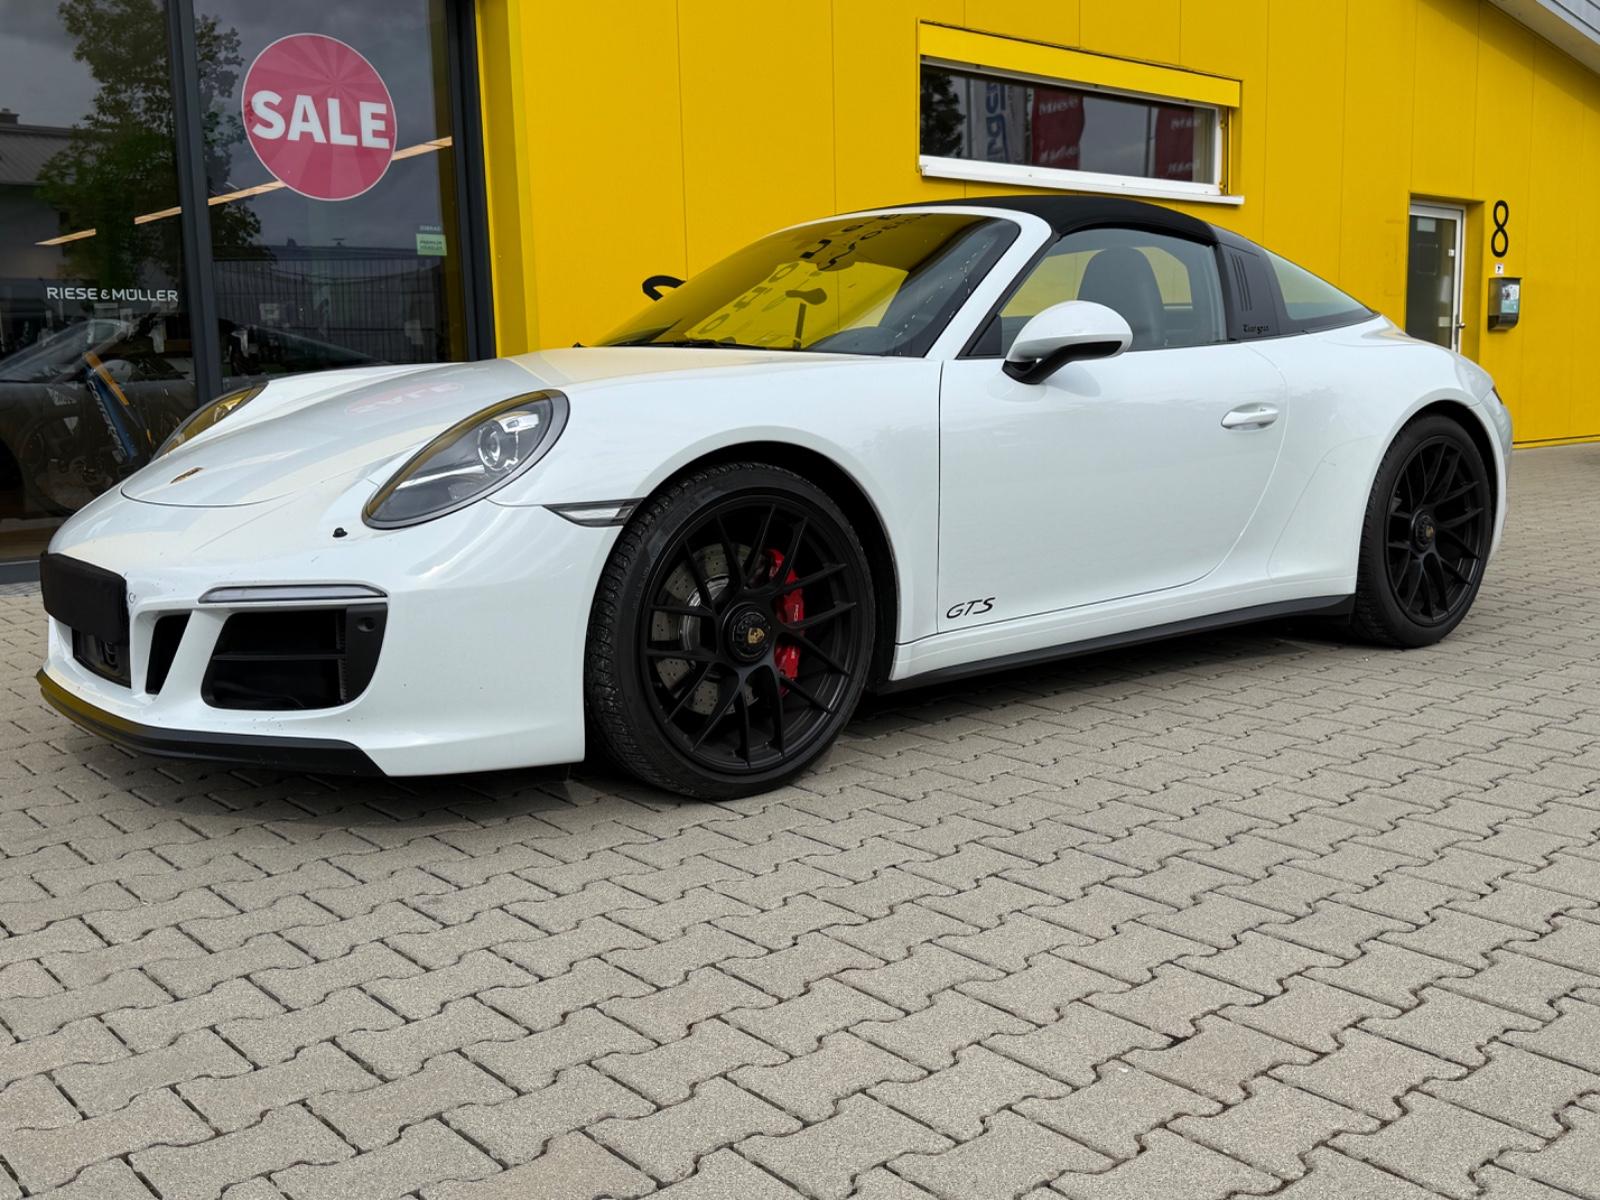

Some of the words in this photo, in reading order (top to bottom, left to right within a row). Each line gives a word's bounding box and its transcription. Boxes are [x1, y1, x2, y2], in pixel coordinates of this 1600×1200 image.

[251, 90, 390, 149] SALE
[1491, 200, 1509, 258] 8
[47, 287, 98, 300] RIESE
[112, 288, 178, 302] MÜLLER
[946, 597, 996, 619] GTS
